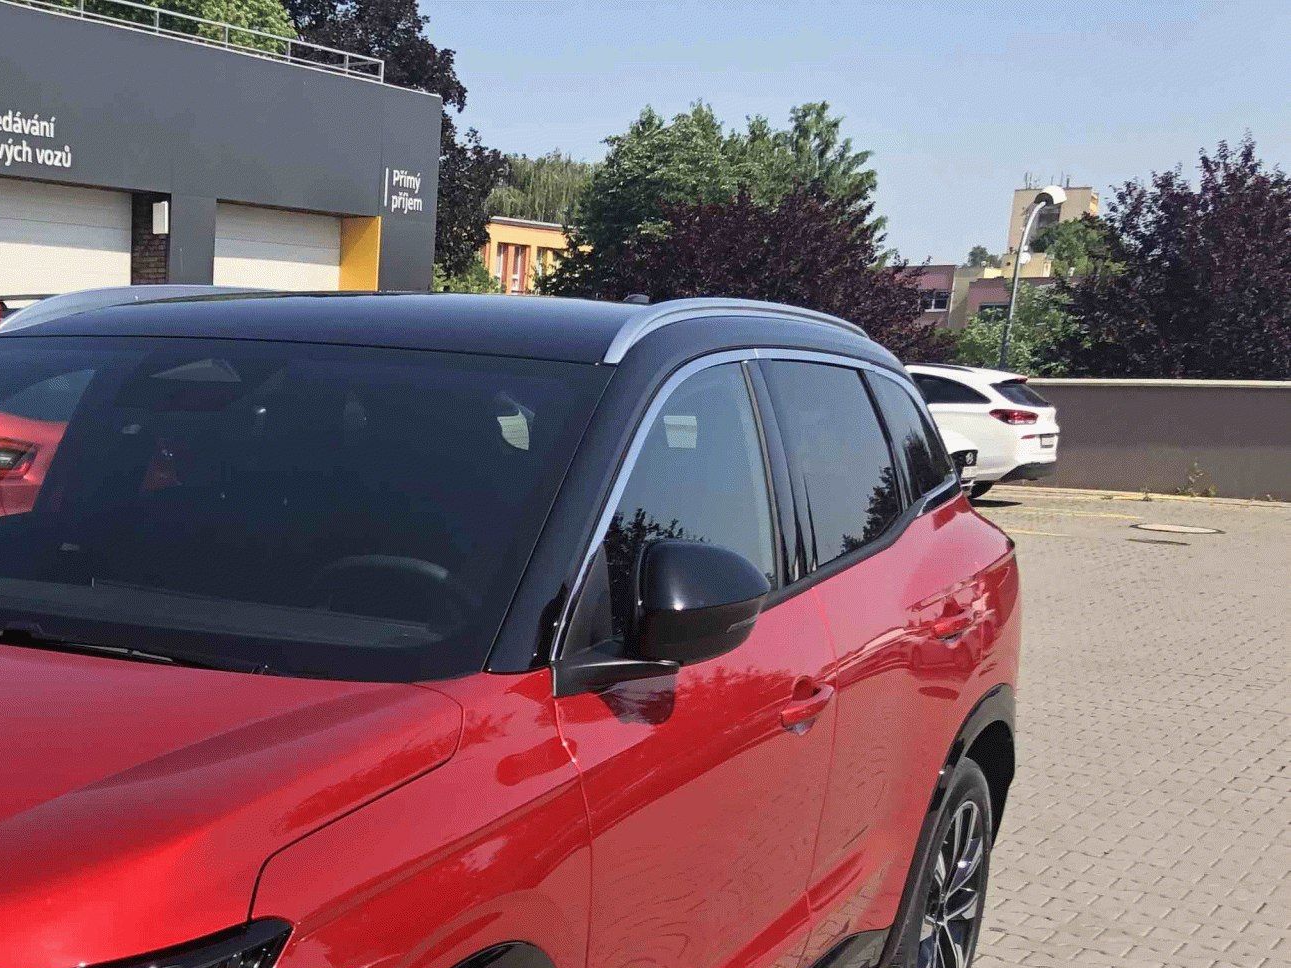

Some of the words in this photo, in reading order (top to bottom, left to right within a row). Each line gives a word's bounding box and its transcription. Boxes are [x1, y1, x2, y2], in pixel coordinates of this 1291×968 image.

[35, 145, 72, 168] vozů
[392, 169, 421, 194] Přímý
[391, 191, 423, 214] příjem
